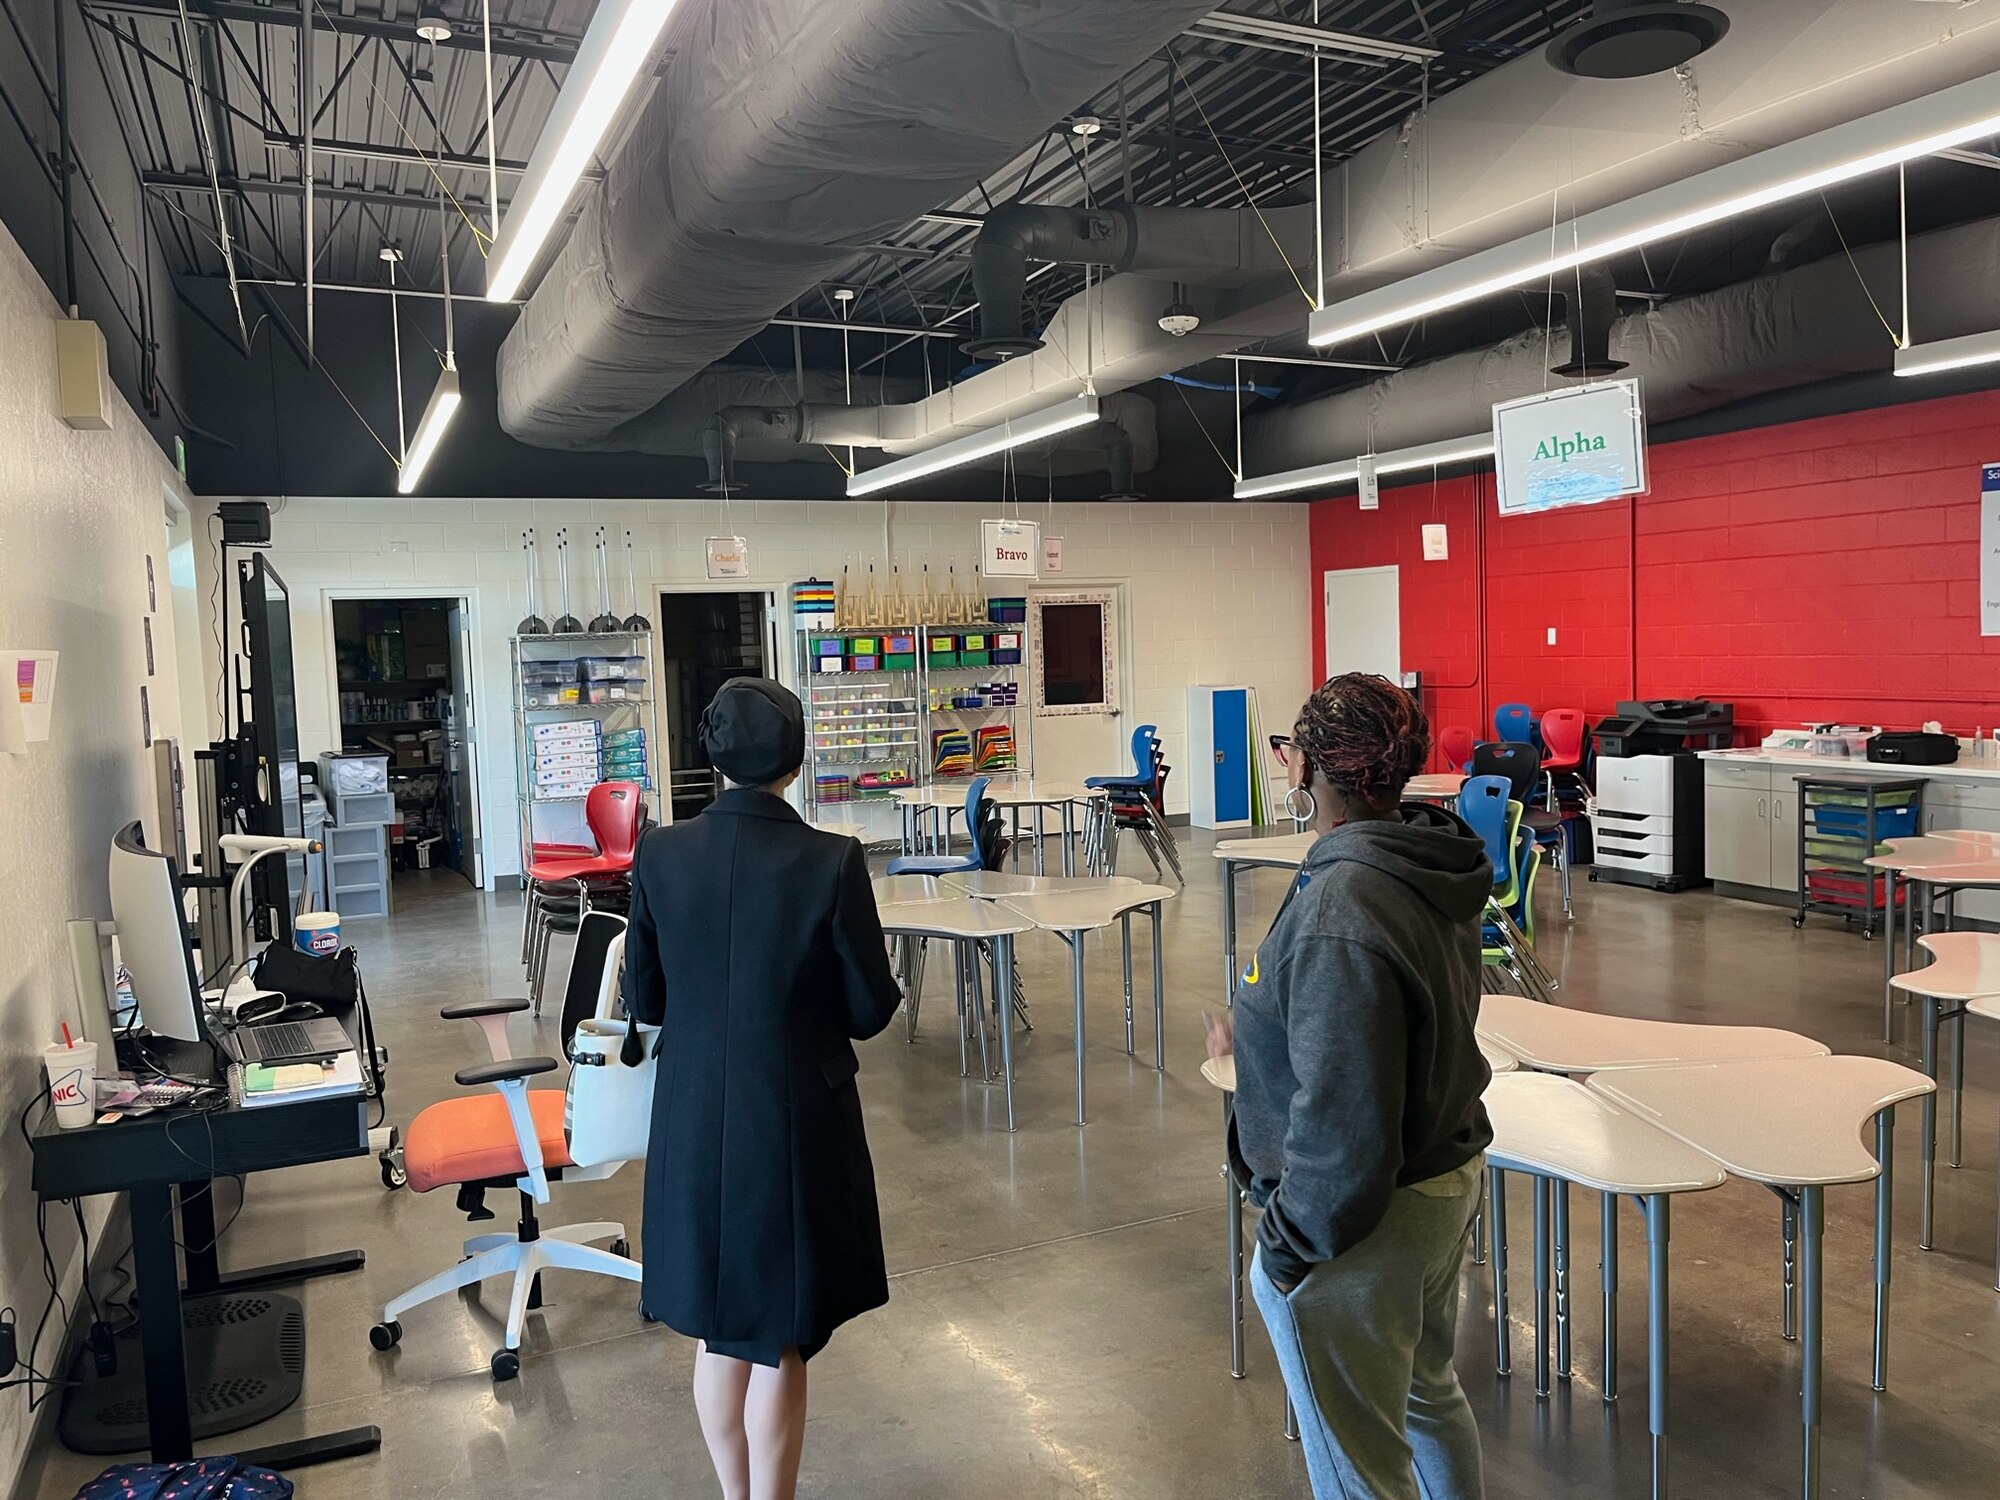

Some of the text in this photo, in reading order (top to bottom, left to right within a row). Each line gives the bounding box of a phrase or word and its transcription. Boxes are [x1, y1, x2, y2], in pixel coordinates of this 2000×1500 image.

[1532, 431, 1607, 463] Alpha
[714, 552, 741, 562] Charlie
[995, 547, 1028, 561] Bravo
[53, 1084, 77, 1103] NIC
